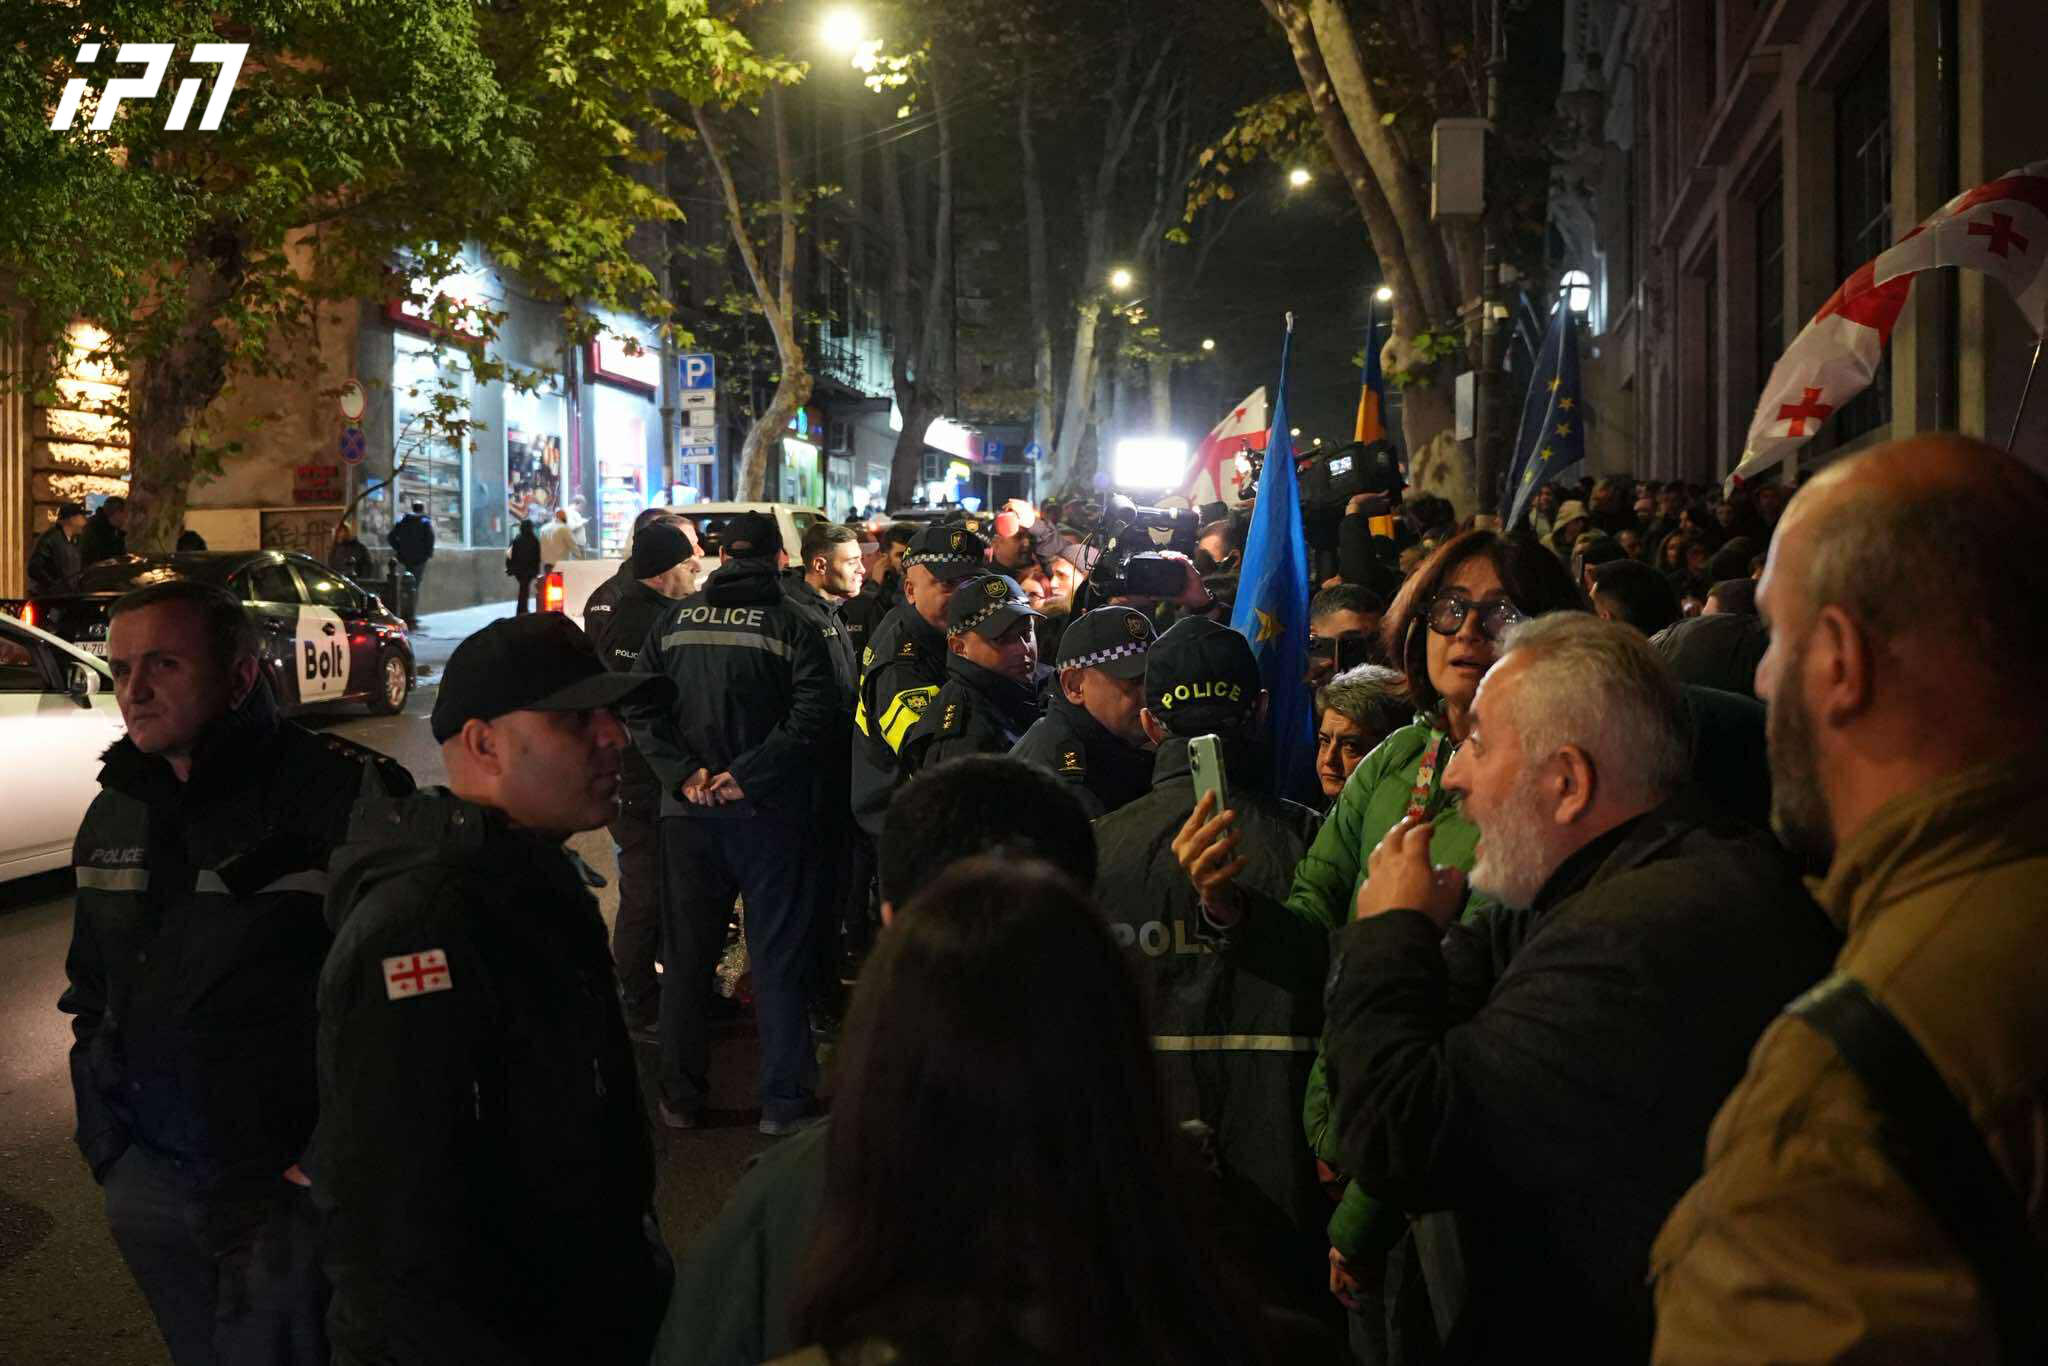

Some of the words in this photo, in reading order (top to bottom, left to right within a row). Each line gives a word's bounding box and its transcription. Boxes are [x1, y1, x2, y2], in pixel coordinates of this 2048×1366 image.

[687, 357, 706, 386] P
[677, 606, 765, 628] POLICE
[304, 640, 343, 680] Bolt
[1161, 681, 1241, 710] POLICE
[89, 847, 145, 863] POLICE
[1110, 920, 1213, 957] POL
